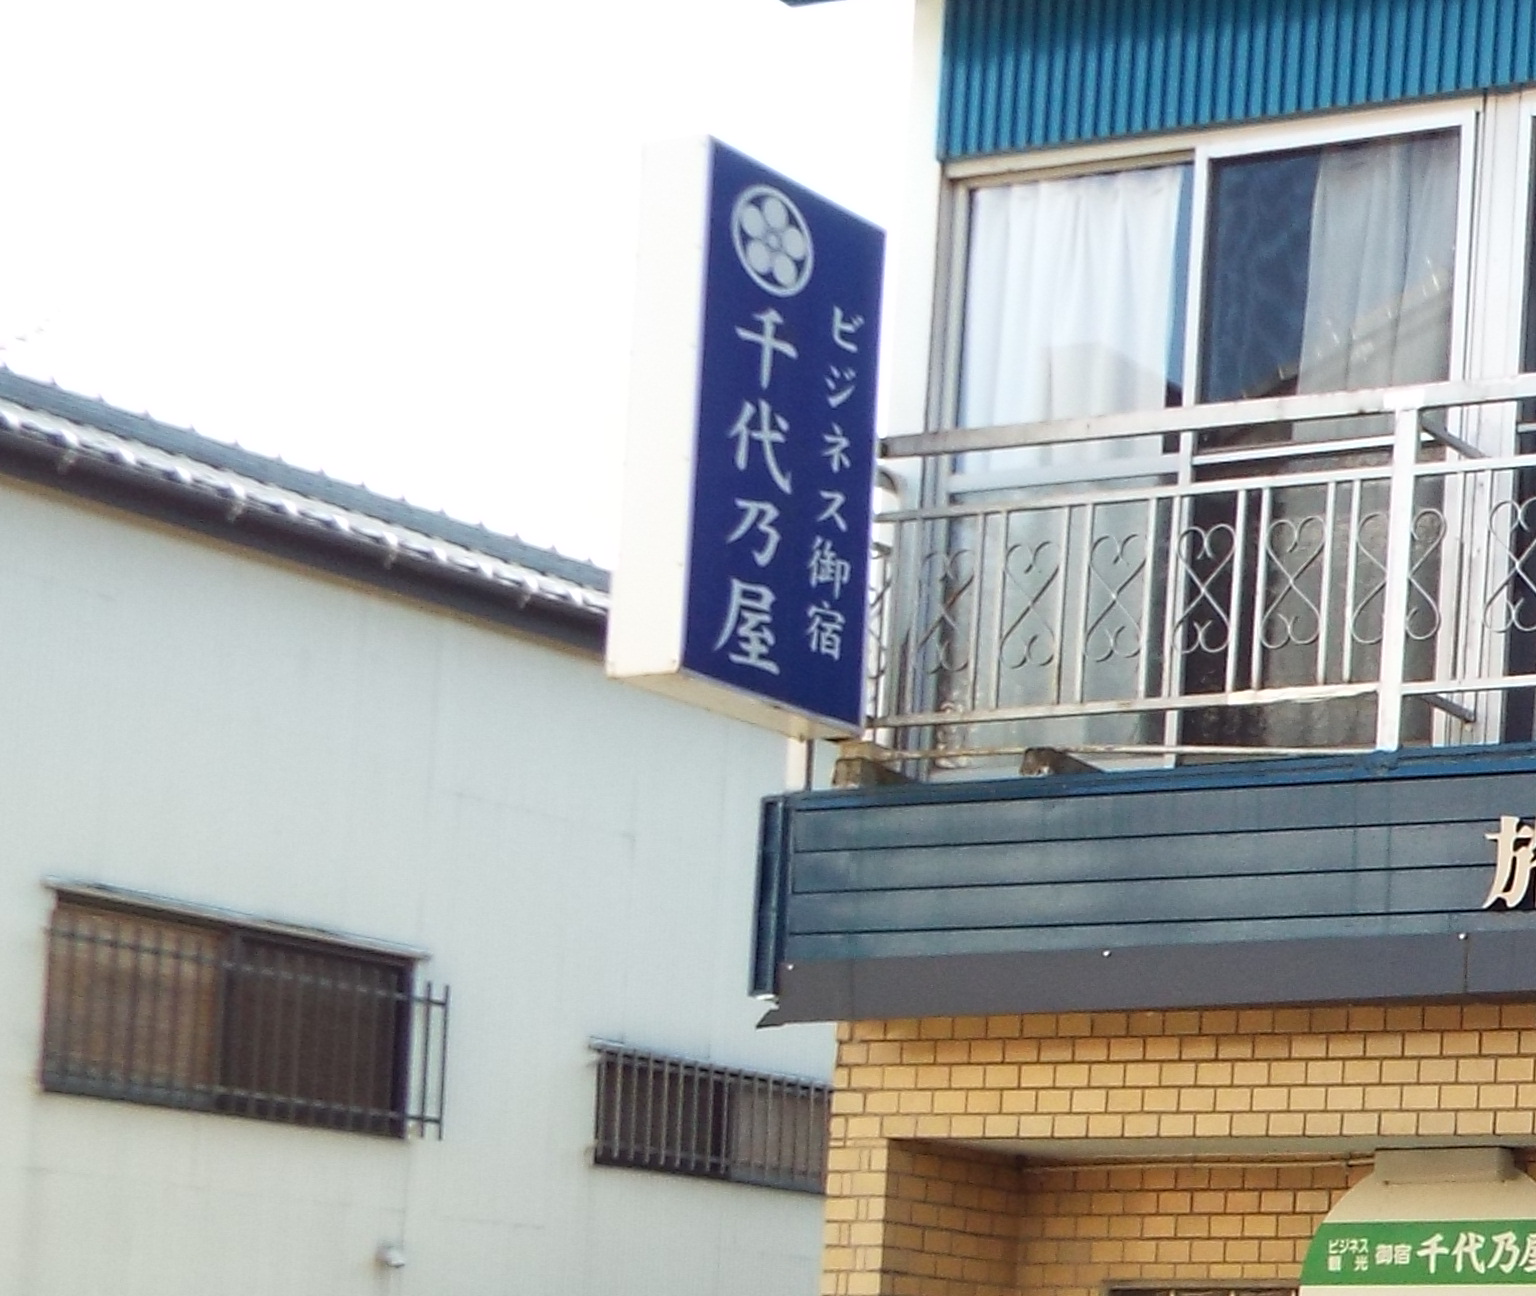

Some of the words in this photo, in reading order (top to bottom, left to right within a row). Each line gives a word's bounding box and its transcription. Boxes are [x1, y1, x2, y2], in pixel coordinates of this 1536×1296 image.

[714, 309, 798, 674] 千代乃屋
[806, 305, 864, 661] ビジネス御宿
[1328, 1238, 1369, 1254] ビジネス
